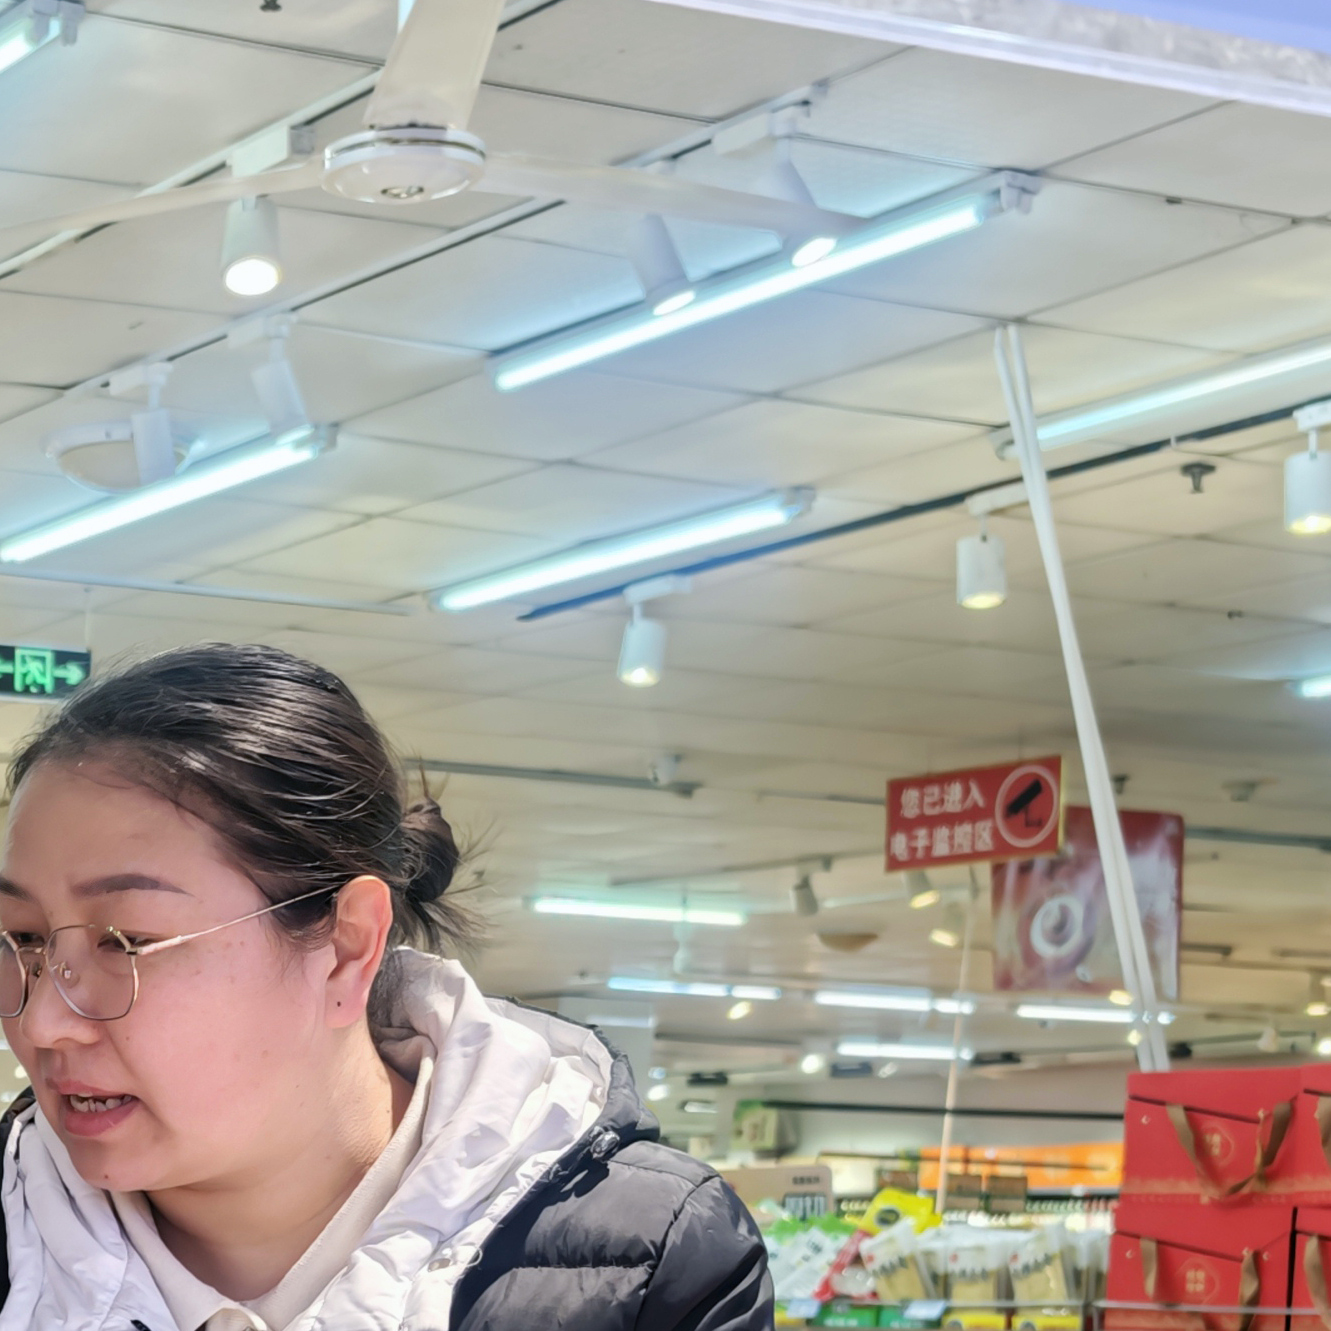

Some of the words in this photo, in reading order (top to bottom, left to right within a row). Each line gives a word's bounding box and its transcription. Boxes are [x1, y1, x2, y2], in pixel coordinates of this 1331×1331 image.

[899, 778, 986, 819] 您已进入
[890, 818, 994, 862] 电子监控区
